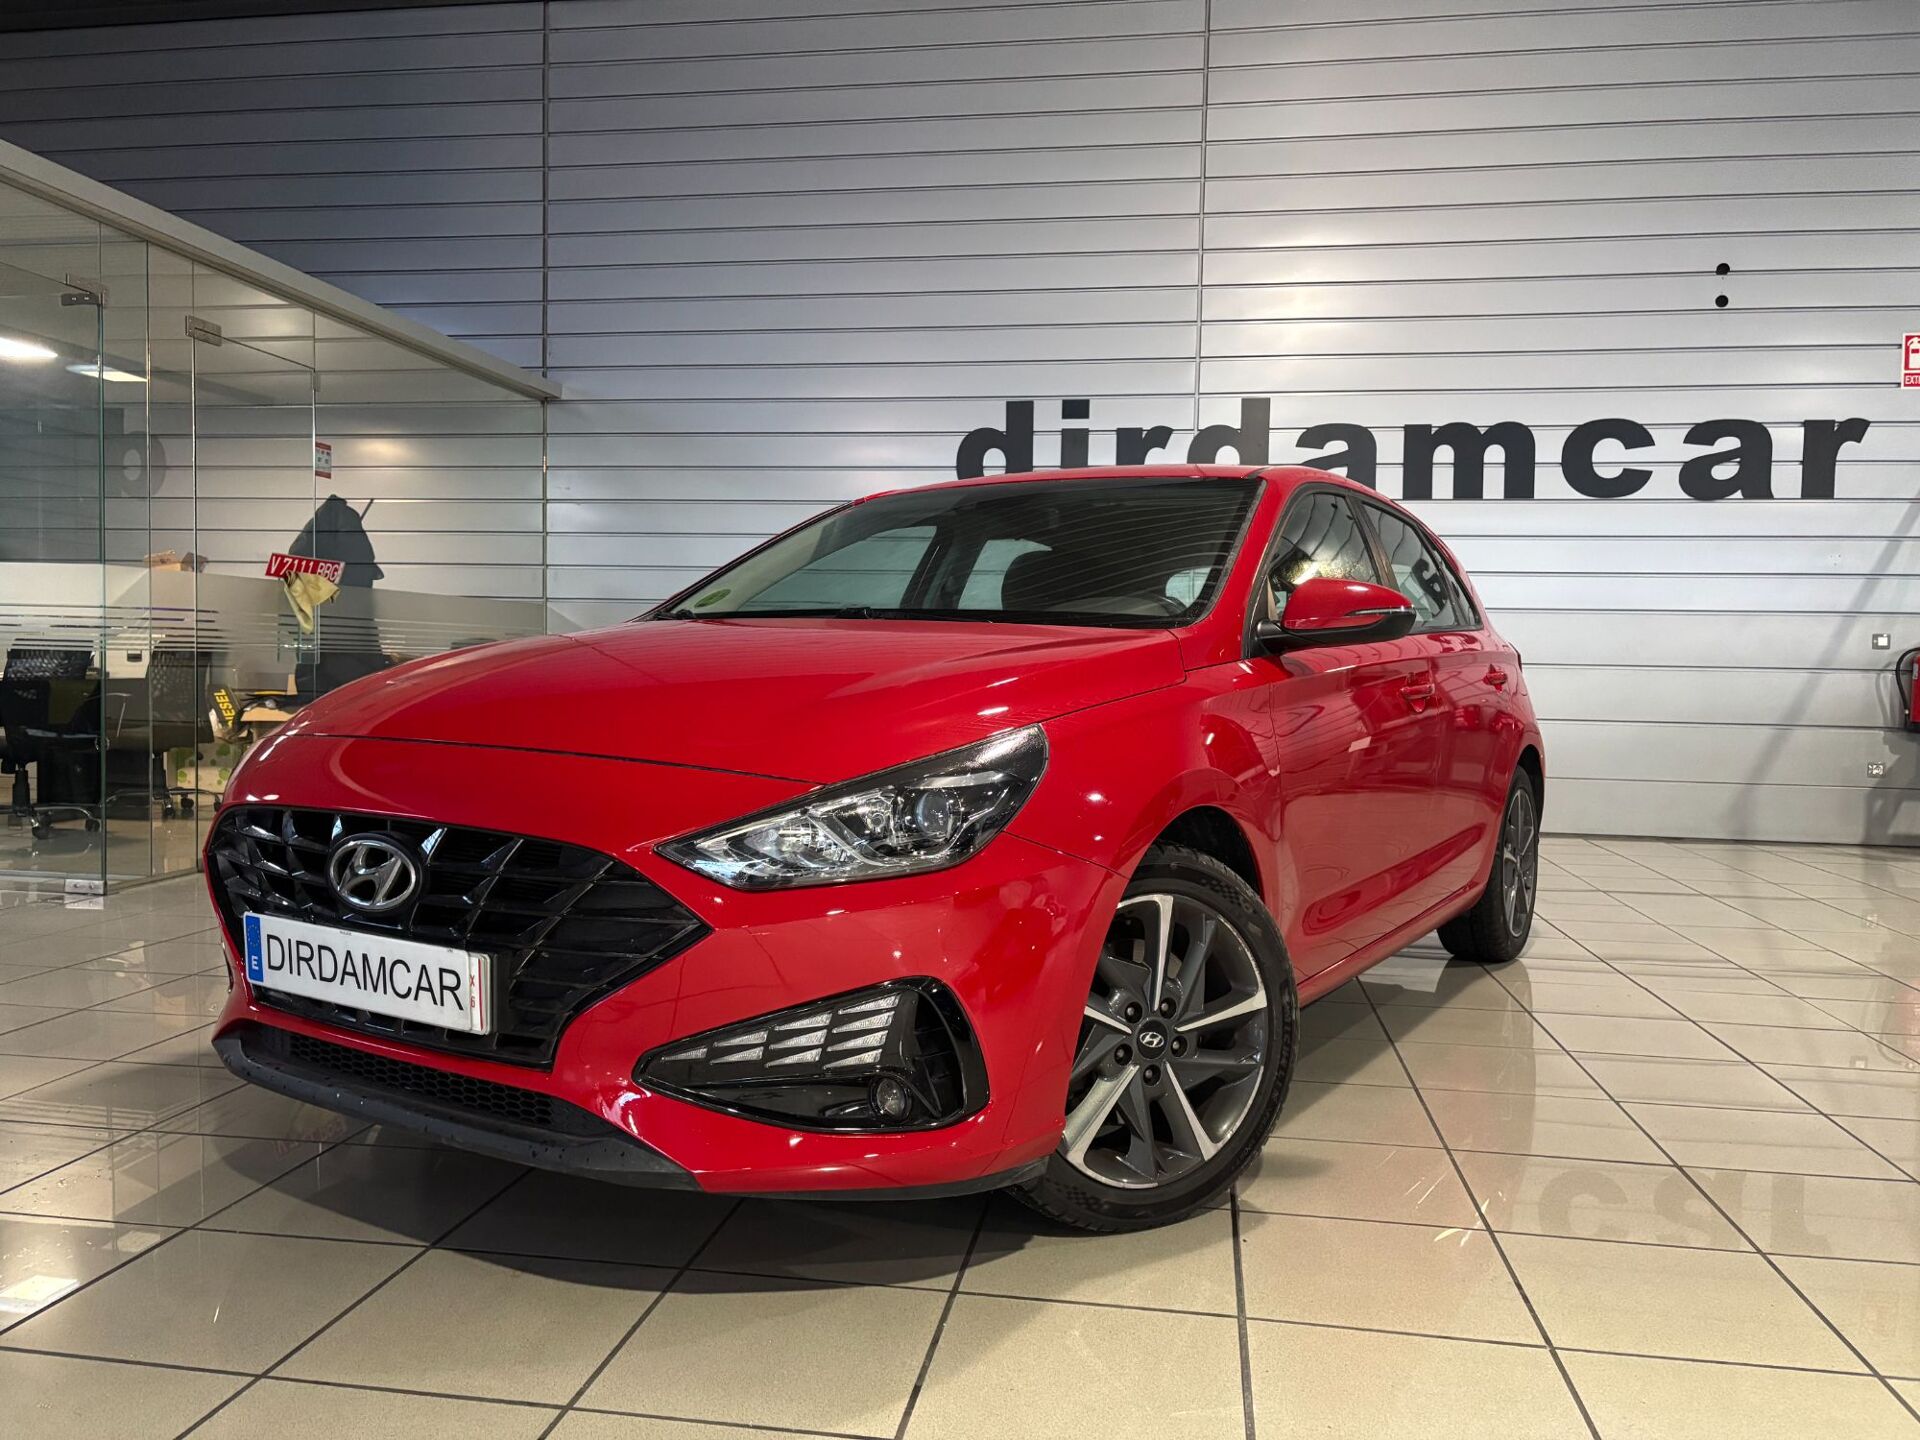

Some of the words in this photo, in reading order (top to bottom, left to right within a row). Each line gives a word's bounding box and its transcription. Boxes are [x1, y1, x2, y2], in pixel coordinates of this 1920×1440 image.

[956, 397, 1871, 500] dirdamcar
[270, 555, 282, 575] V
[280, 557, 314, 576] 7111
[316, 562, 339, 581] BBG
[251, 955, 259, 970] E
[265, 933, 465, 1011] DIRDAMCAR
